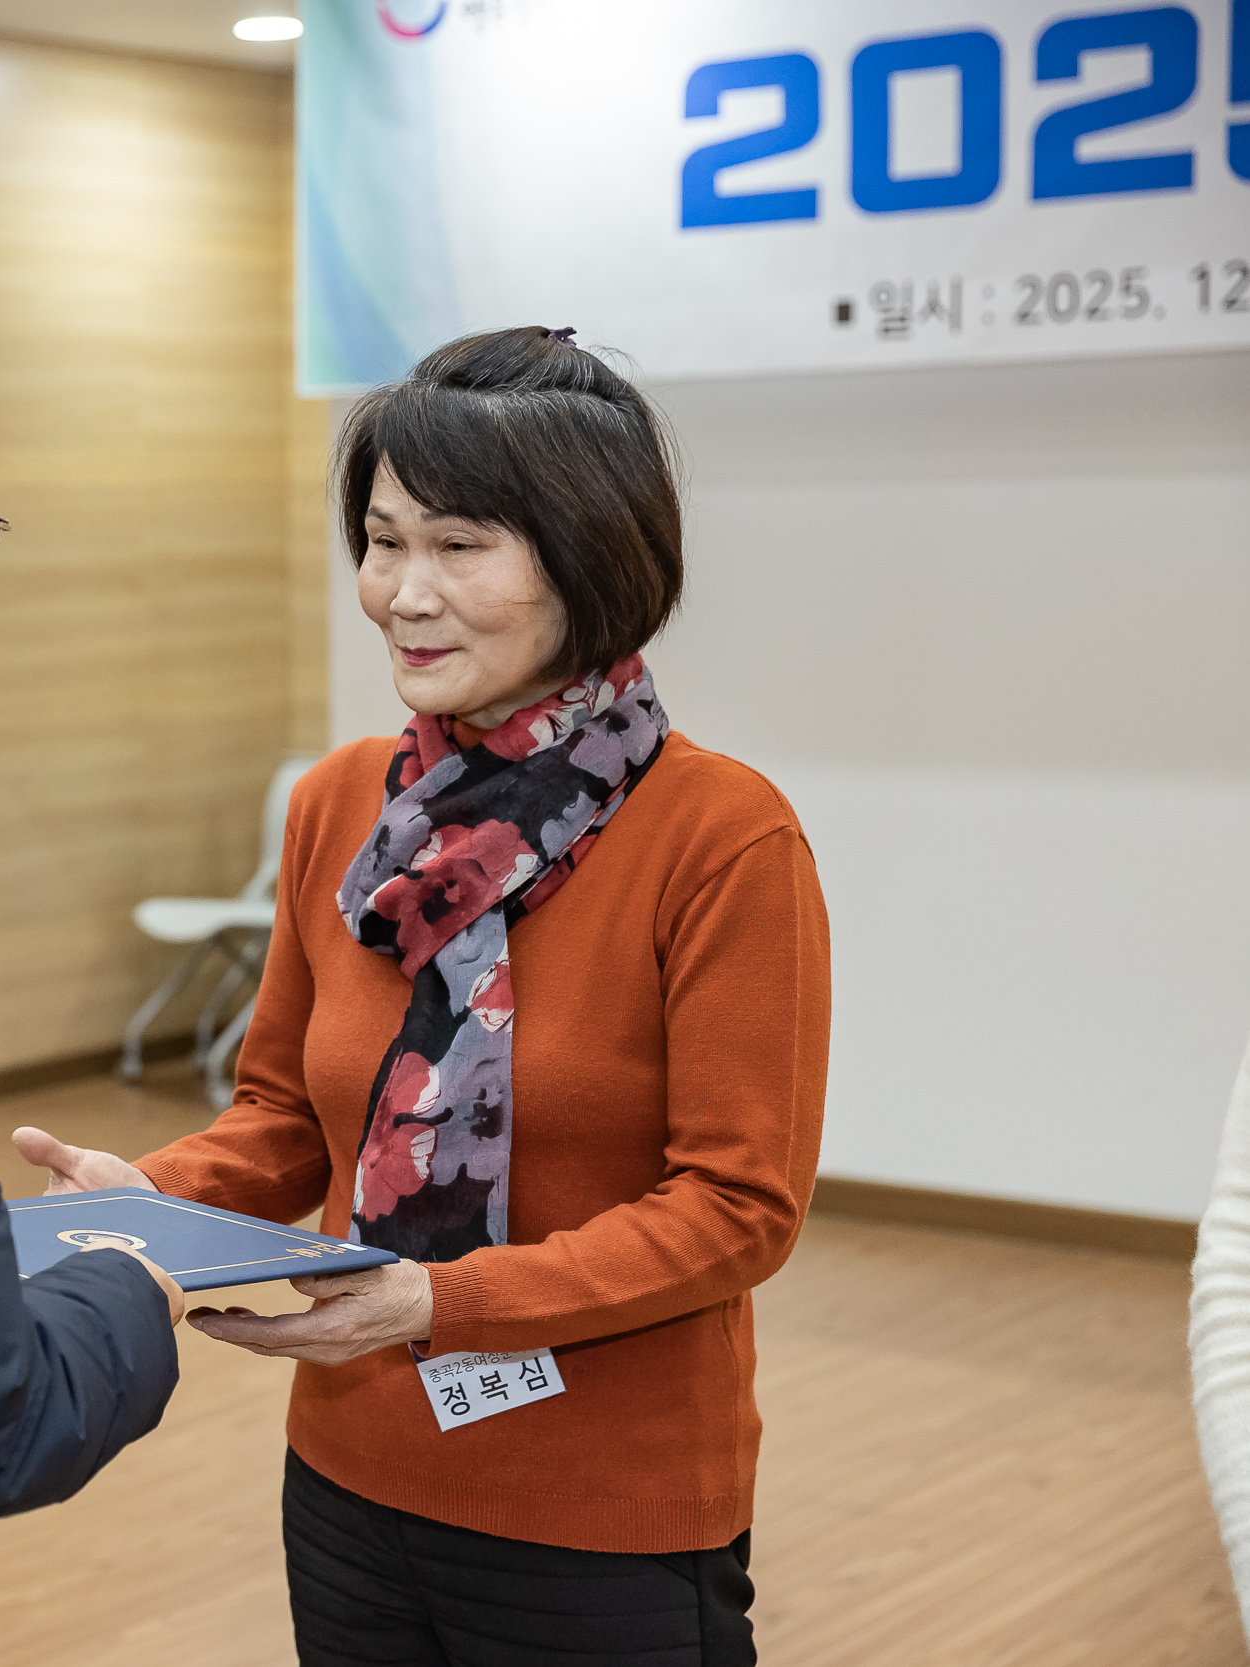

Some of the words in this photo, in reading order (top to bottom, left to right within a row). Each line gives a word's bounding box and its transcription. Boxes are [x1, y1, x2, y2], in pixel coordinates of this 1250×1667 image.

[679, 0, 1250, 231] 202
[868, 274, 964, 340] 일시
[1013, 264, 1167, 328] 2025.
